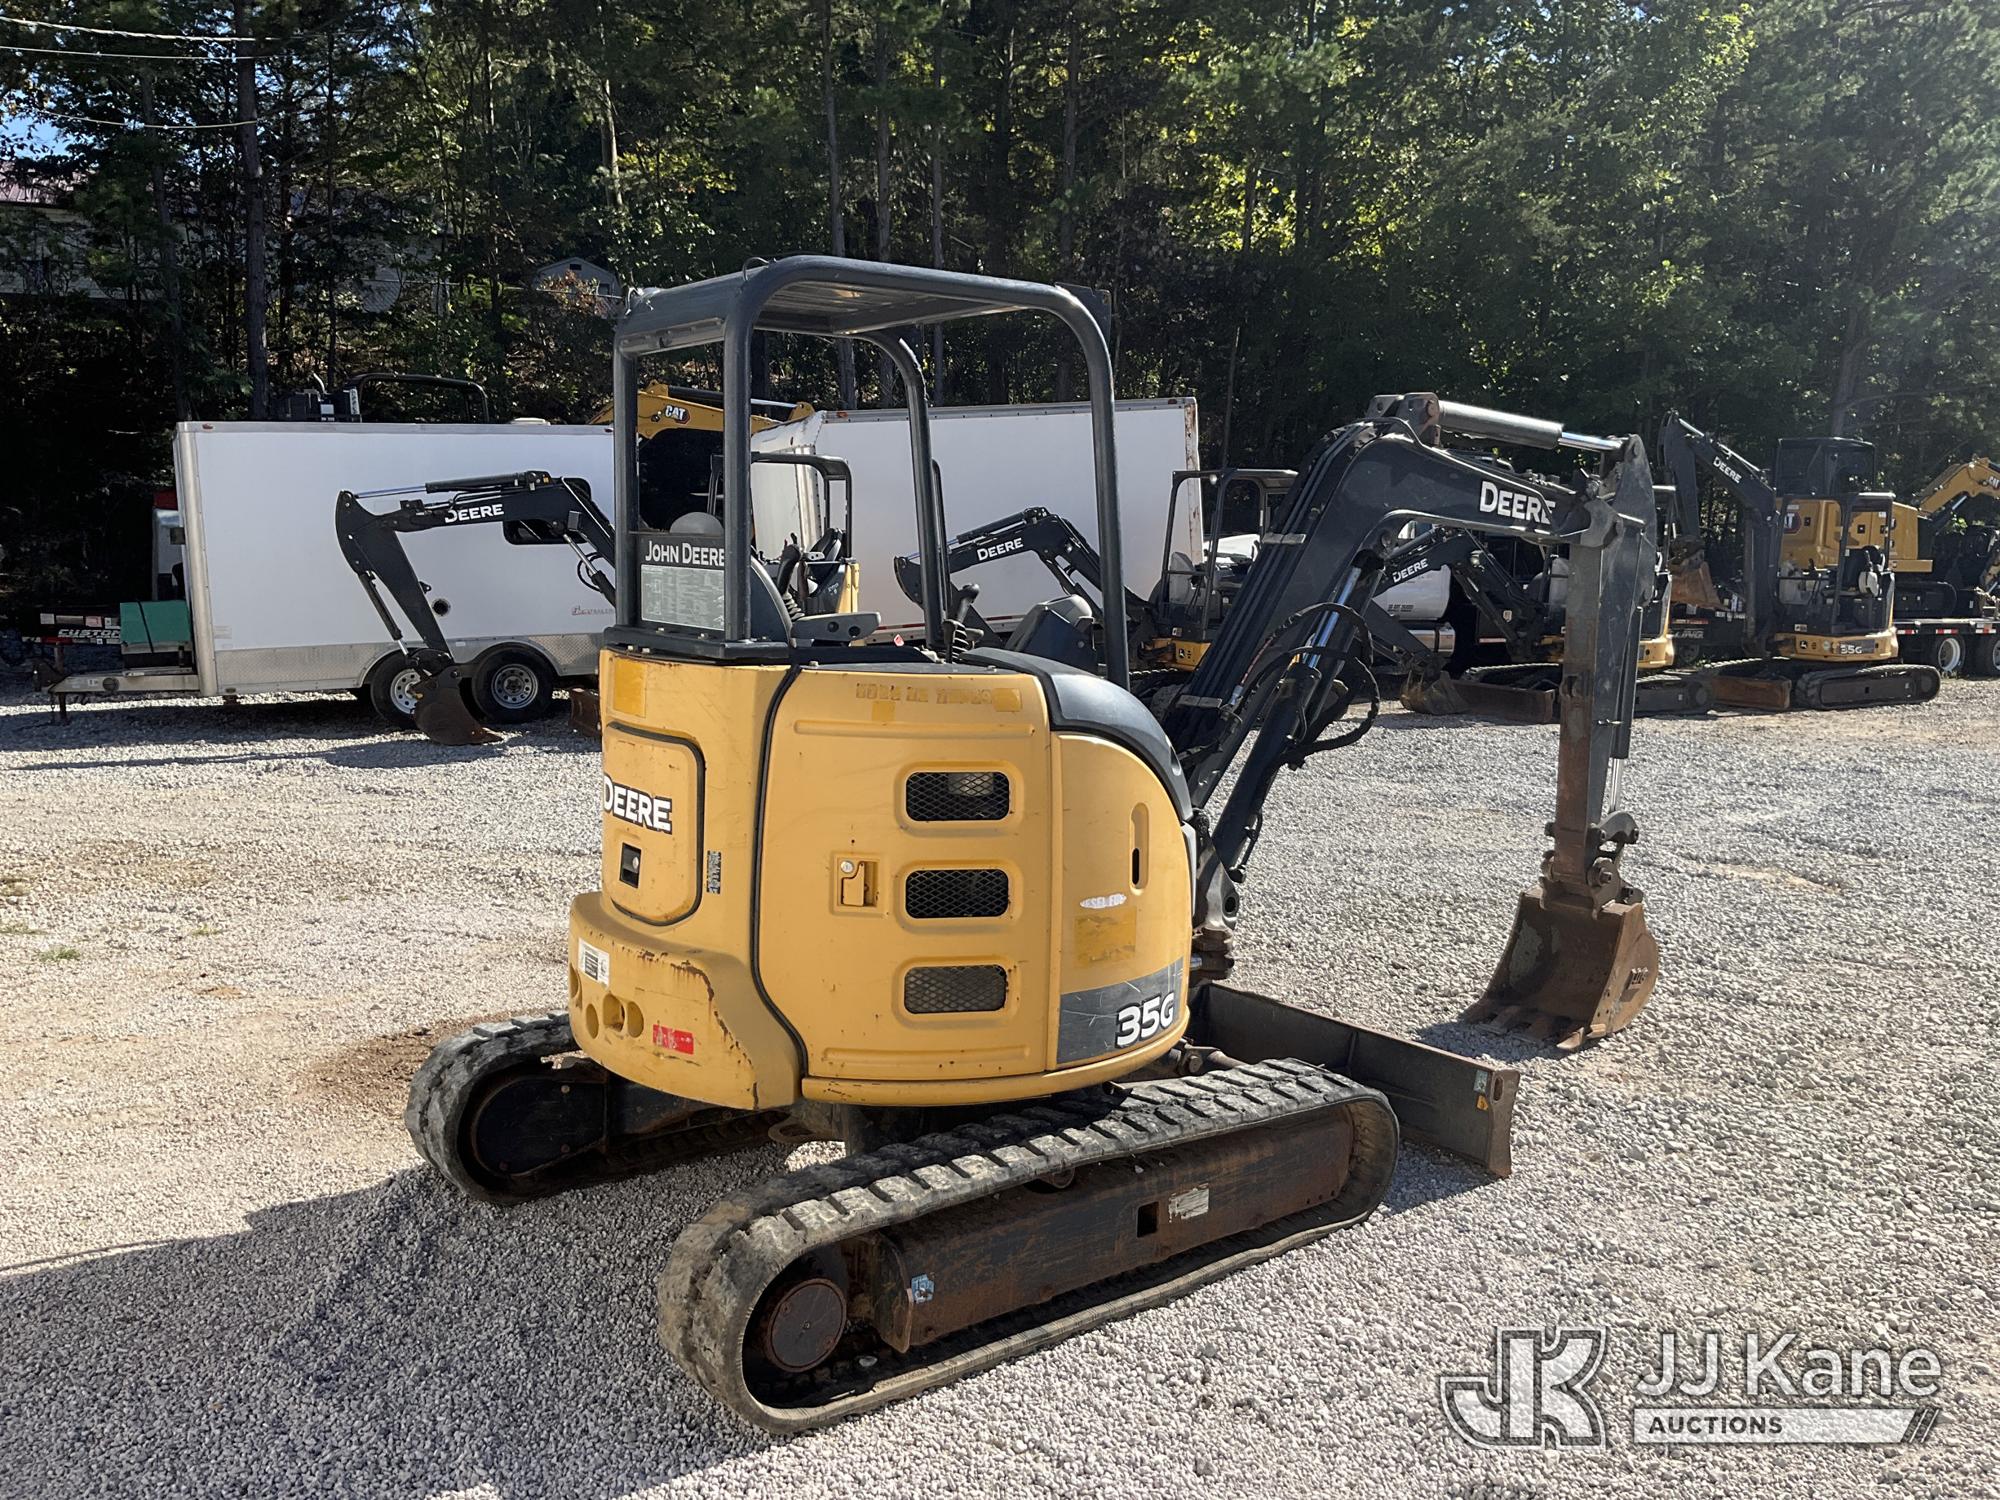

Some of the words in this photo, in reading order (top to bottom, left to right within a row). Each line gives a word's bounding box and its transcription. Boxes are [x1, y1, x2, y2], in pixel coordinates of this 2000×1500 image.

[665, 405, 686, 421] CAT
[1712, 456, 1742, 484] DEERE
[444, 503, 505, 524] DEERE
[1479, 480, 1556, 525] DEERE
[645, 540, 680, 564] JOHN
[682, 542, 725, 567] DEERE
[976, 537, 1024, 561] DEERE
[1392, 558, 1429, 583] DEERE
[1840, 643, 1863, 654] 35G
[603, 773, 673, 835] DEERE
[1115, 989, 1175, 1048] 35G
